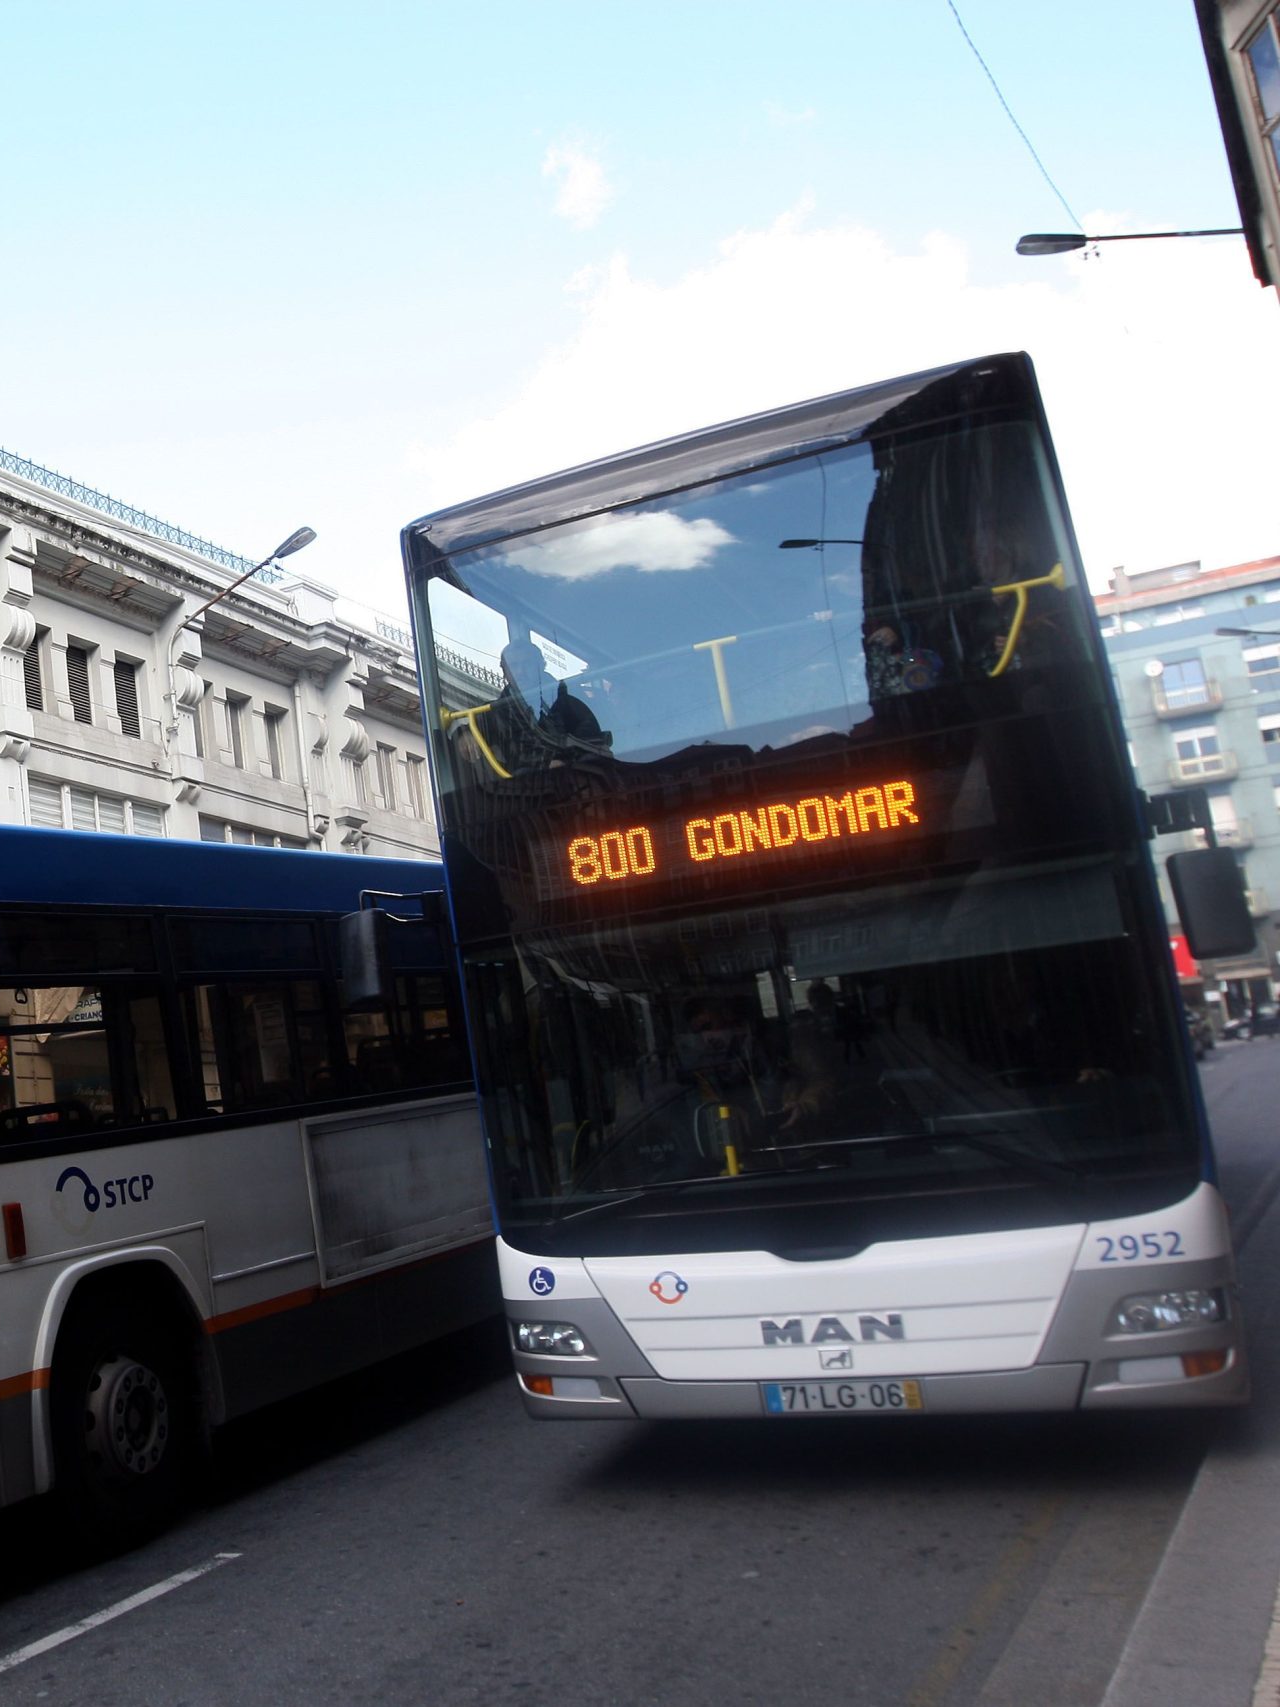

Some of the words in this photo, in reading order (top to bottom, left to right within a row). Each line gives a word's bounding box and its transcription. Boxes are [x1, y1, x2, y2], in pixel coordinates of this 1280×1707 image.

[568, 827, 656, 884] 800
[687, 781, 918, 861] GONDOMAR
[103, 1174, 153, 1208] STCP
[1097, 1231, 1186, 1262] 2952
[760, 1313, 905, 1346] MAN
